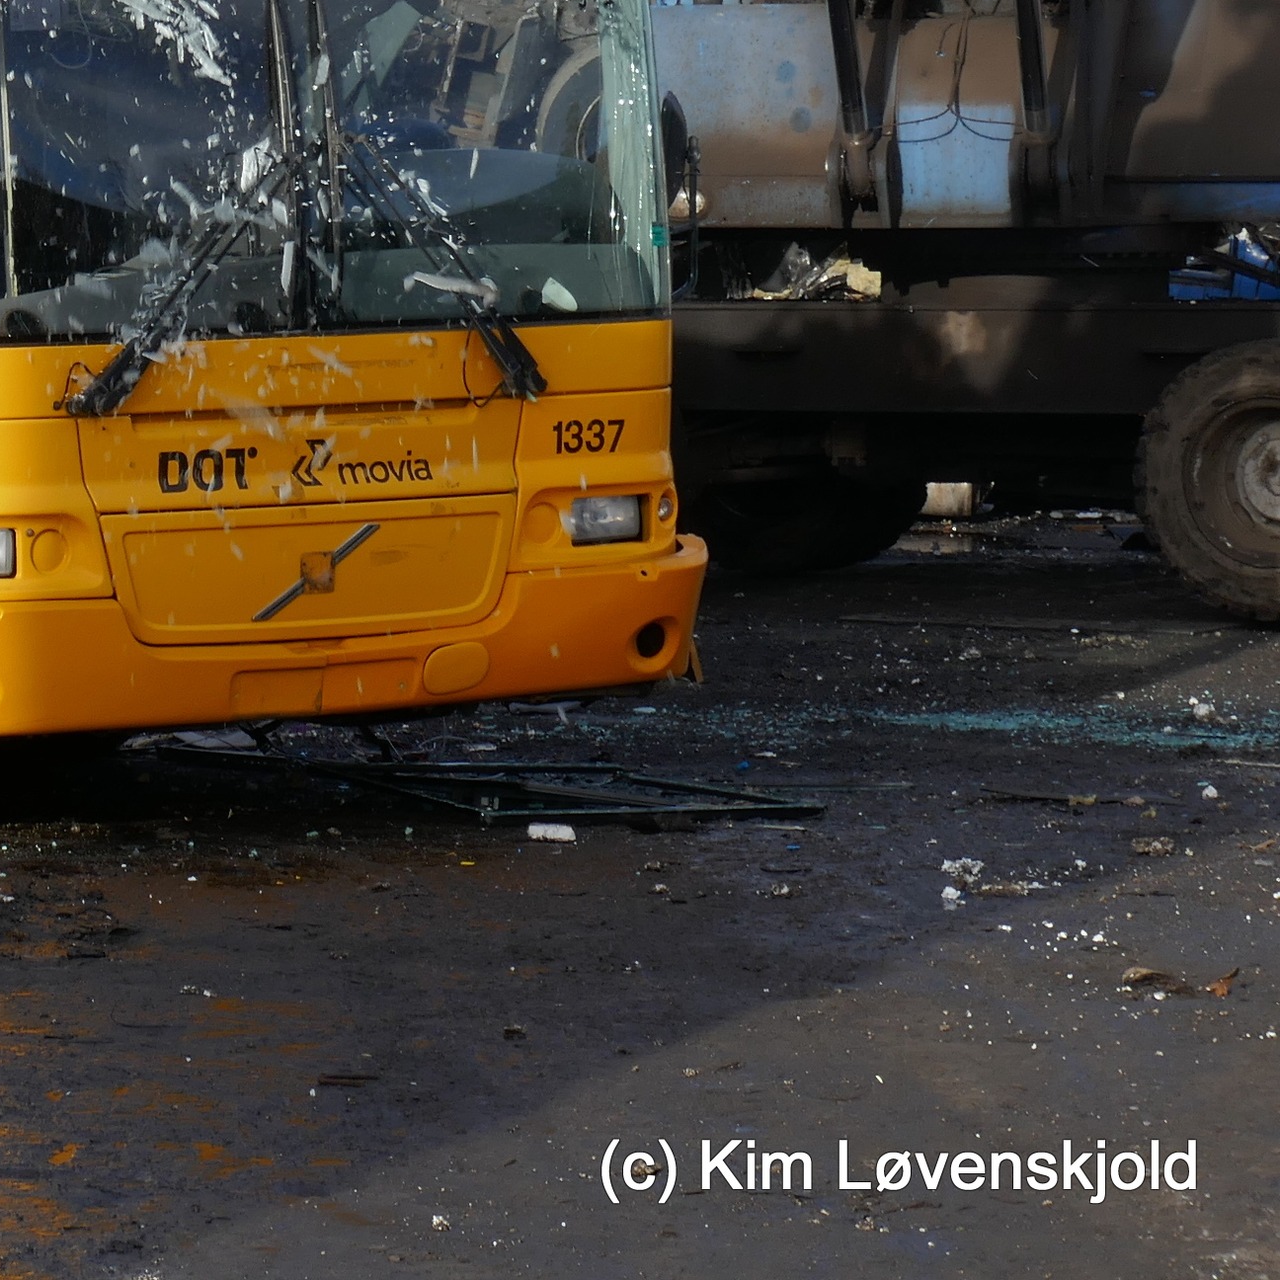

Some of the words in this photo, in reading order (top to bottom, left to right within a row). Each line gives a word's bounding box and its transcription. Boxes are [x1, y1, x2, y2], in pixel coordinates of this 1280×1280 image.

[553, 419, 625, 454] 1337
[158, 447, 257, 493] DOT
[339, 450, 433, 485] movia
